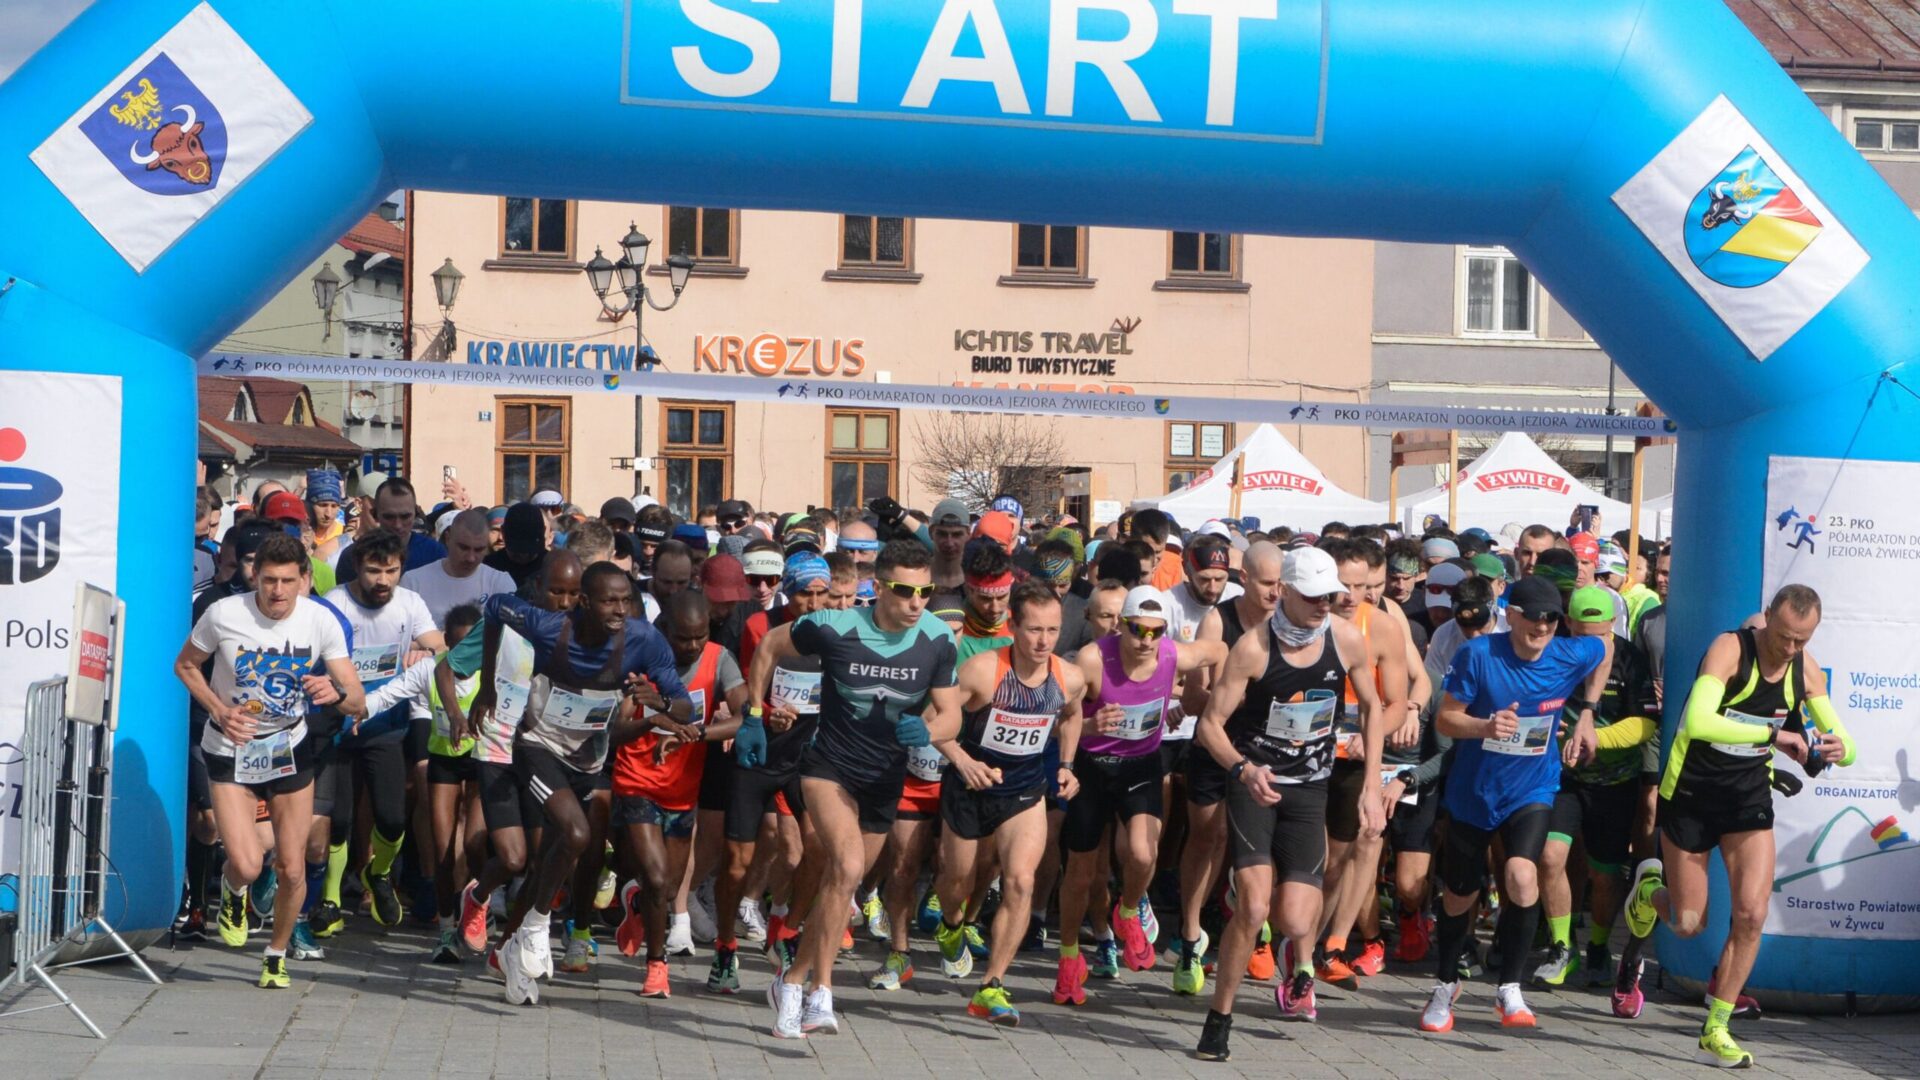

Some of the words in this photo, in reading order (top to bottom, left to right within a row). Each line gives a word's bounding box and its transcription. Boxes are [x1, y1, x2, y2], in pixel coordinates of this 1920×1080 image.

[671, 0, 1277, 126] START
[954, 329, 1033, 351] ICHTIS
[1041, 332, 1134, 355] TRAVEL
[255, 361, 282, 372] PKO
[287, 361, 377, 377] PÓŁMARATON
[383, 368, 446, 380] DOOKOŁA
[452, 370, 501, 383] JEZIORA
[507, 372, 594, 387] ŻYWIECKIEGO
[971, 356, 1012, 374] BIURO
[1018, 357, 1117, 376] TURYSTYCZNE
[817, 387, 844, 399] PKO
[849, 387, 935, 404] PÓŁMARATON
[942, 393, 1003, 407] DOOKOŁA
[1008, 395, 1057, 409] JEZIORA
[1062, 395, 1146, 413] ŻYWIECKIEGO
[1334, 409, 1360, 420] PKO
[1365, 408, 1449, 424] PÓŁMARATON
[1456, 414, 1516, 426] DOOKOŁA
[1521, 415, 1568, 428] JEZIORA
[1575, 416, 1656, 431] ŻYWIECKIEGO
[1829, 516, 1847, 527] 23.
[1850, 518, 1874, 530] PKO
[1828, 530, 1906, 545] PÓŁMARATON
[1827, 546, 1872, 559] JEZIORA
[849, 663, 919, 681] EVEREST
[1850, 672, 1920, 691] Wojewód
[775, 684, 810, 701] 1778
[501, 697, 512, 710] 5
[1848, 691, 1904, 713] Śląskie
[561, 706, 573, 717] 2
[1286, 718, 1295, 728] 1
[993, 726, 1041, 746] 3216
[242, 755, 269, 770] 540
[1815, 787, 1898, 799] ORGANIZATOR
[1786, 896, 1855, 912] Starostwo
[1830, 919, 1841, 929] w
[1845, 915, 1885, 932] Żywcu
